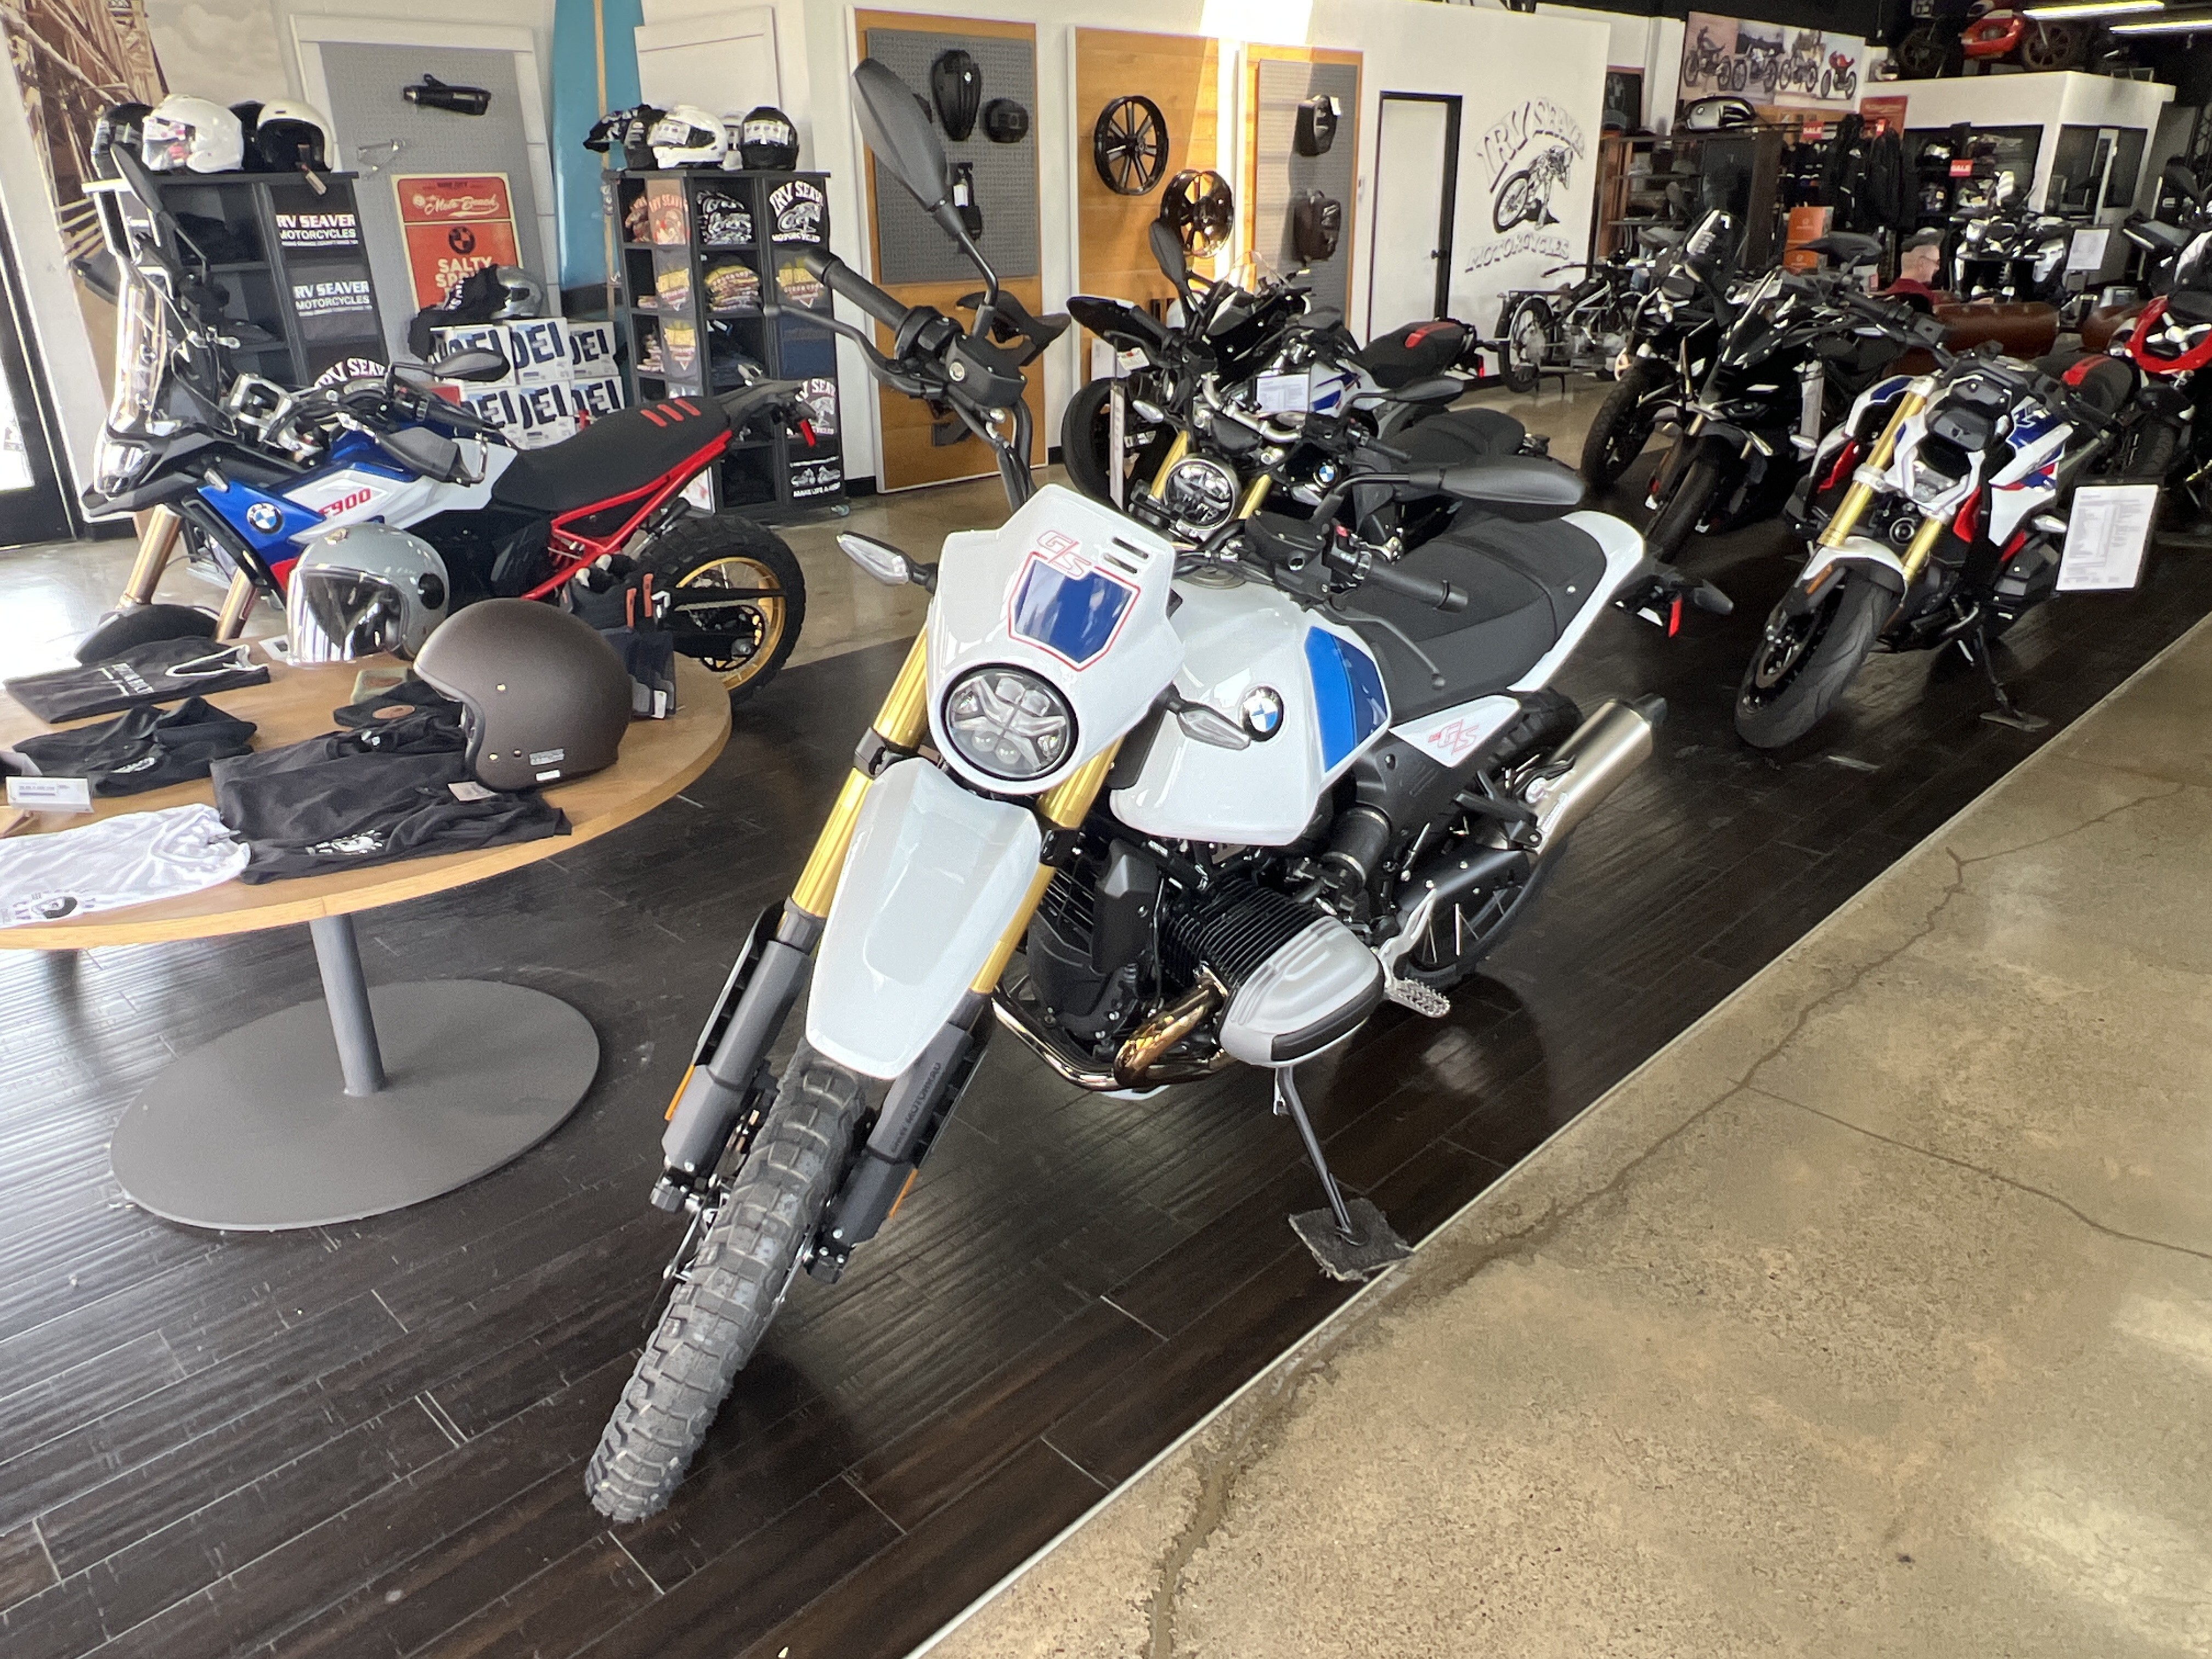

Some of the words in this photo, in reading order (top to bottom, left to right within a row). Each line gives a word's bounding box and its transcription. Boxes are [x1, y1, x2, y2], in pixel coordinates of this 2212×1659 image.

[769, 182, 793, 217] IRV
[299, 214, 356, 228] SEAVER
[1464, 230, 1569, 273] MOTORCYCLES
[438, 256, 492, 273] SALTY
[316, 281, 370, 296] SEAVER
[295, 295, 370, 310] MOTORCYCLES
[318, 487, 371, 516] F900
